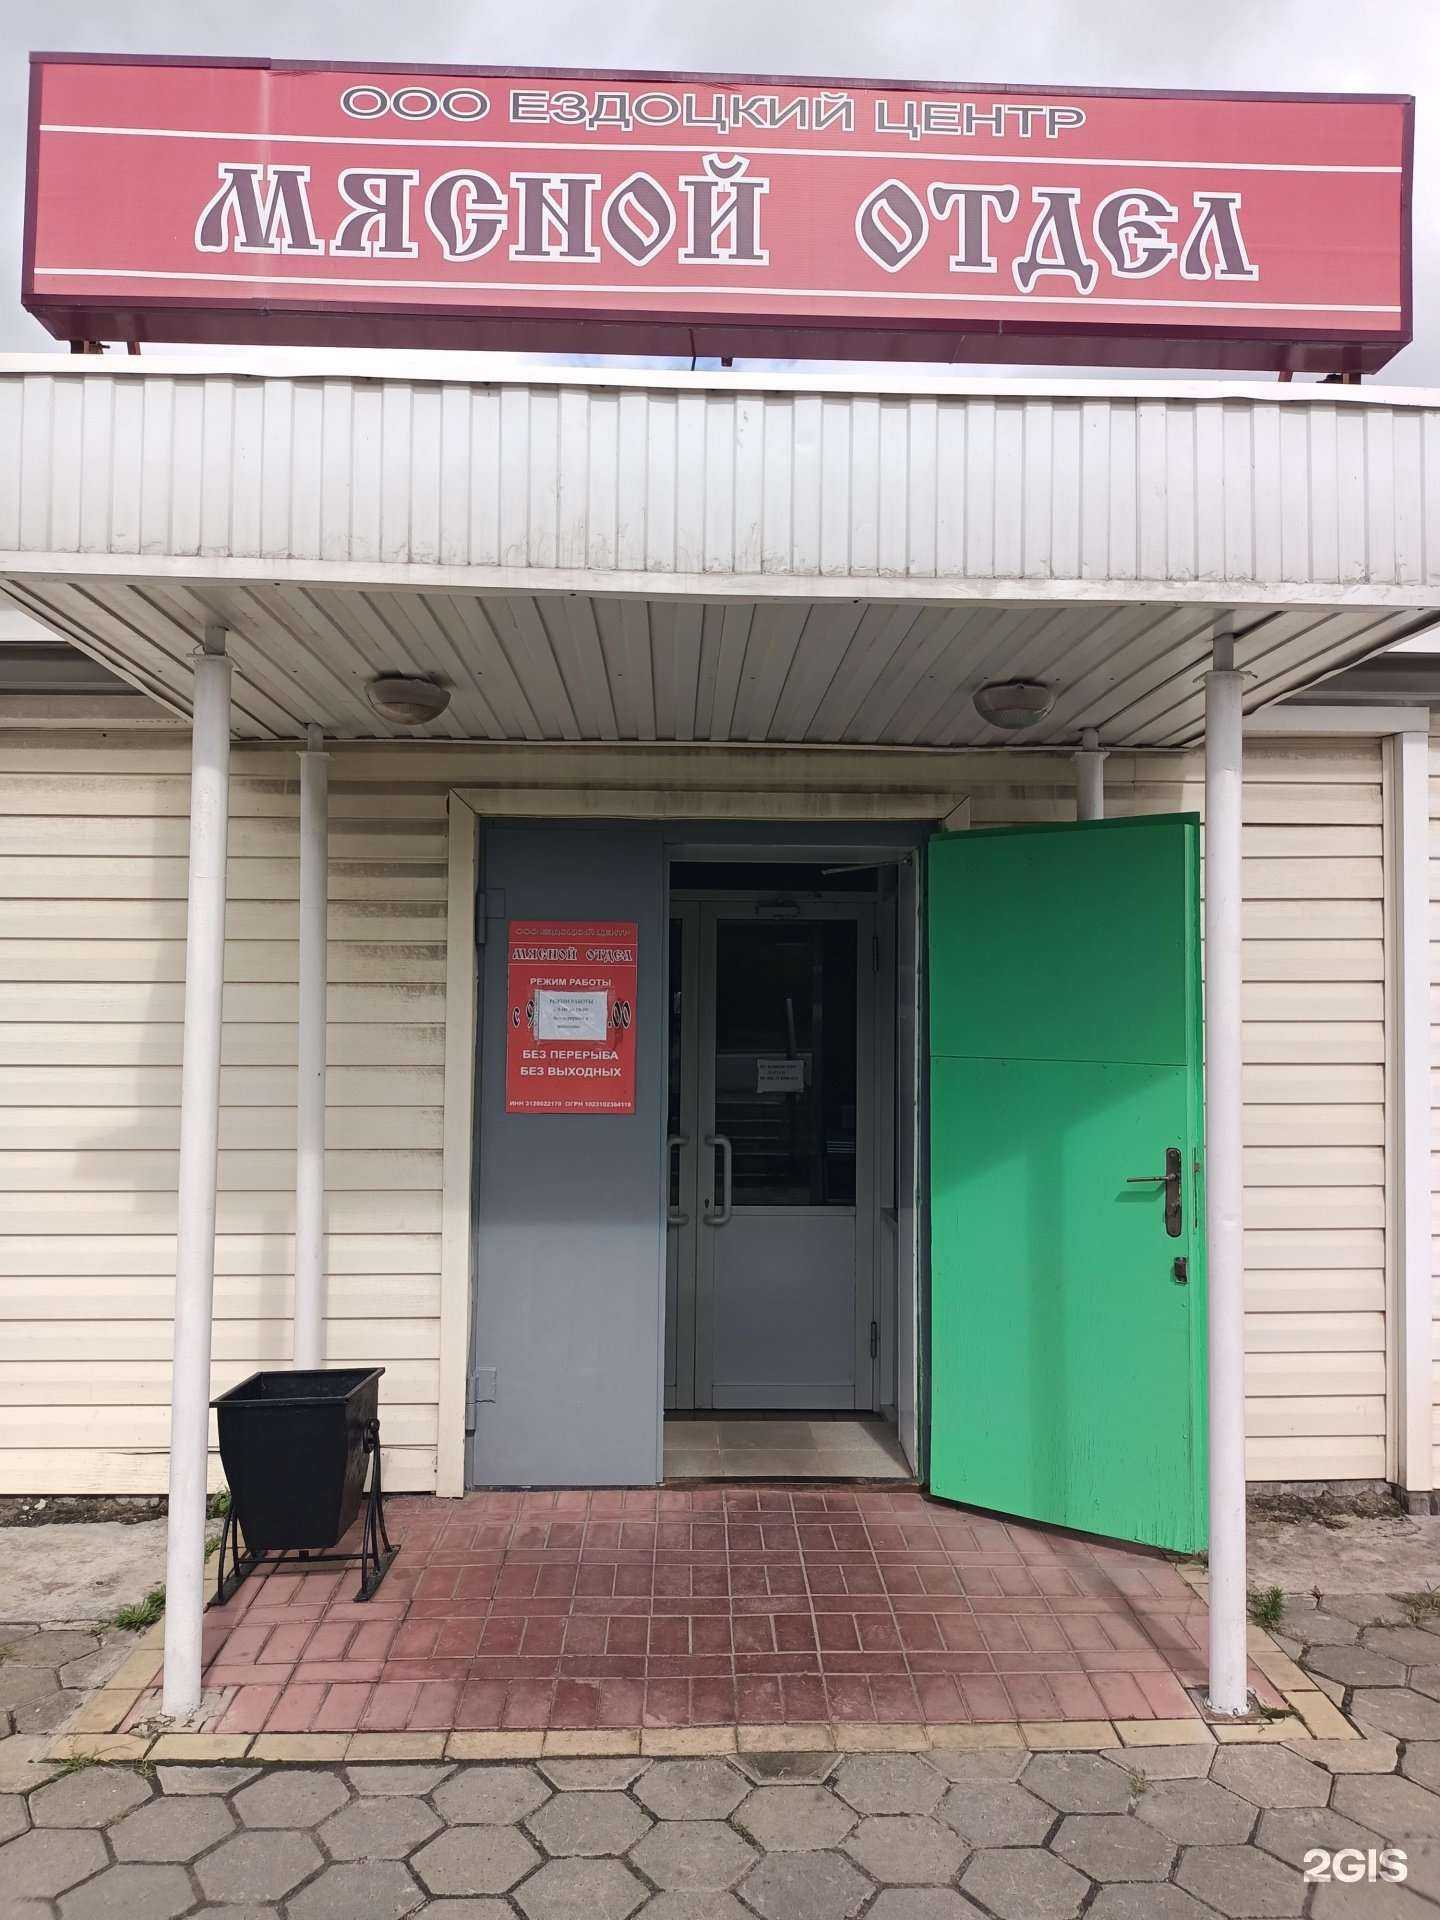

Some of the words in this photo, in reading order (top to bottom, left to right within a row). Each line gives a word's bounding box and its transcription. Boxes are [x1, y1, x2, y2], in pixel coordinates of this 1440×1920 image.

[341, 85, 490, 121] ООО
[509, 89, 855, 134] ЕЗДОЦКИЙ
[874, 99, 1087, 141] ЦЕНТР
[194, 153, 770, 267] МЯСНОЙ
[854, 178, 1259, 295] ОТДЕЛ
[512, 947, 577, 961] МЯСНОЙ
[585, 949, 633, 963] ОТДЕЛ
[530, 978, 567, 986] РЕЖИМ
[569, 979, 612, 987] РАБОТЫ
[523, 1050, 546, 1059] БЕЗ
[520, 1066, 544, 1076] БЕЗ
[548, 1066, 622, 1078] ВЫХОДНЫХ
